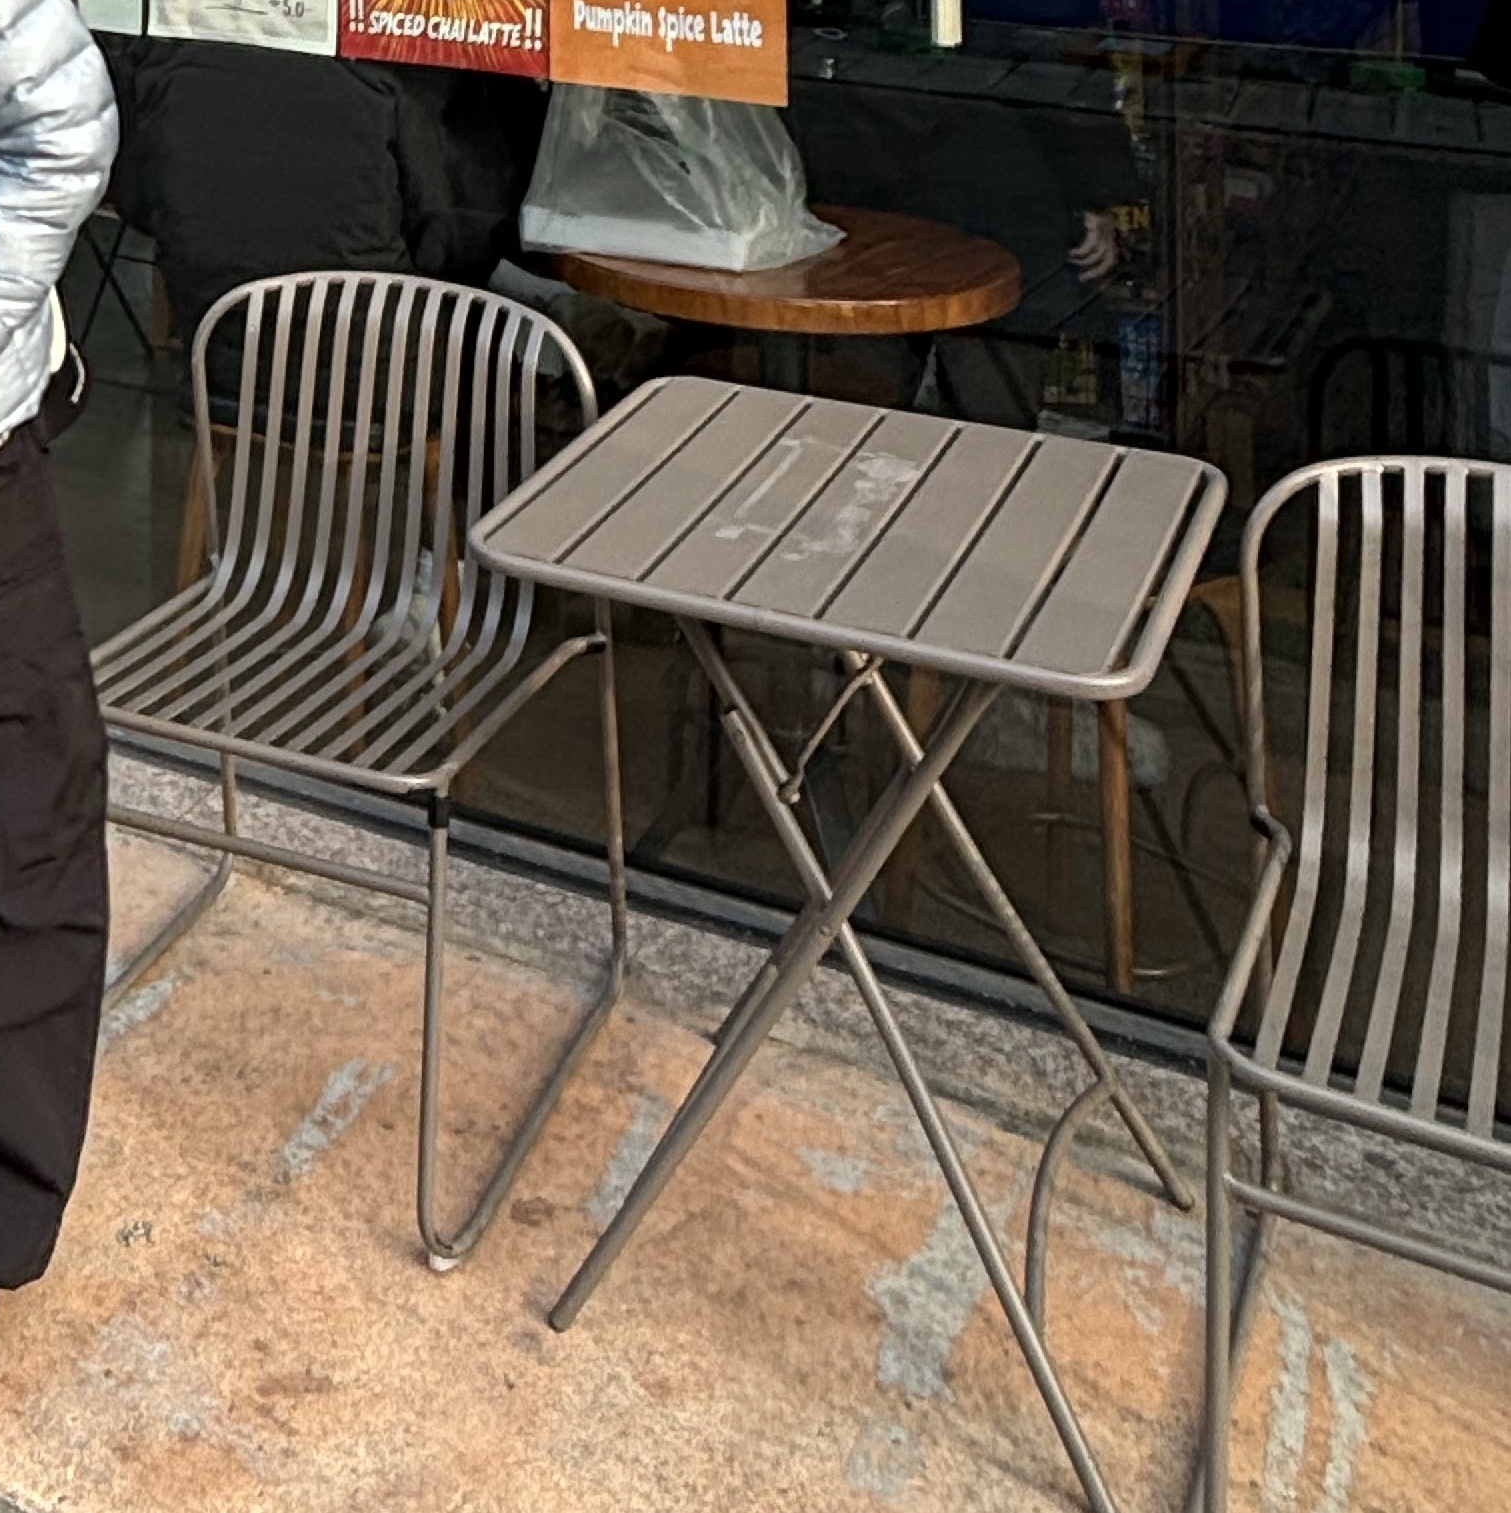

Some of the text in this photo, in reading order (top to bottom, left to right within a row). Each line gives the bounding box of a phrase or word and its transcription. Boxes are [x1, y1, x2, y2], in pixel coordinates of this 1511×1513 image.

[368, 10, 425, 36] SPICED
[427, 15, 467, 42] CHAI
[467, 20, 523, 48] LATTE
[657, 6, 705, 52] Spice
[709, 10, 763, 48] Latte
